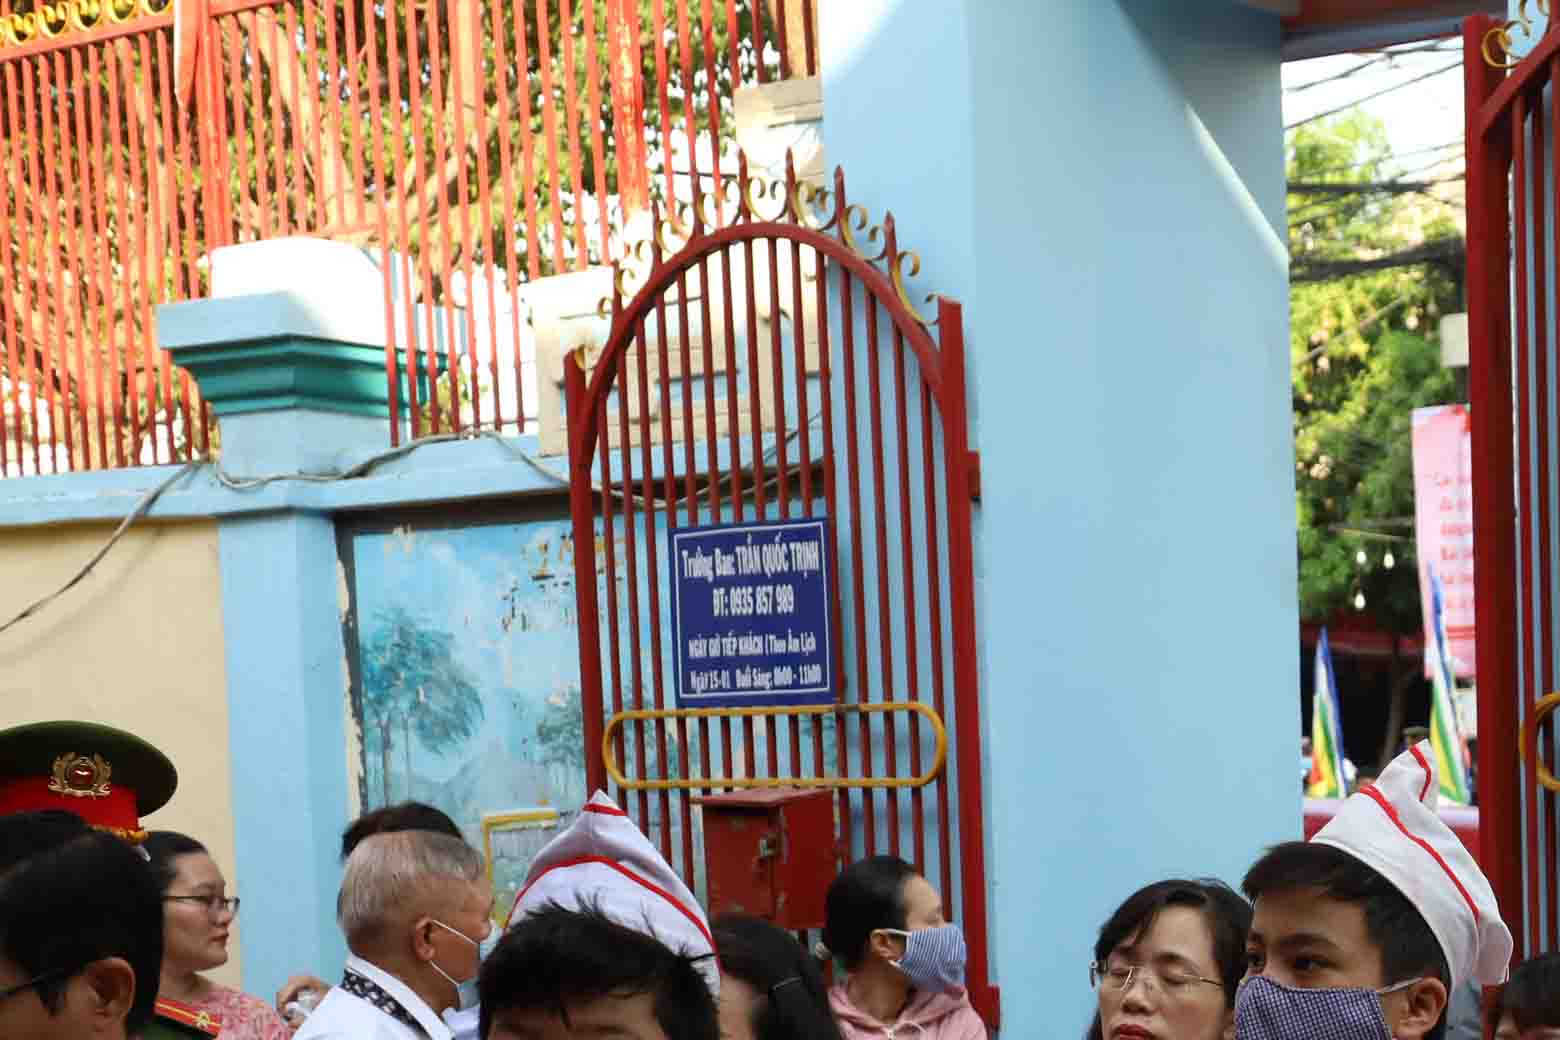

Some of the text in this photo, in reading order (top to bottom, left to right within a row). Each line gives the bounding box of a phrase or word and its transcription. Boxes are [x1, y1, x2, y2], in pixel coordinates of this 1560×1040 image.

[762, 532, 789, 578] QUỐC
[730, 585, 753, 616] 0935
[755, 585, 773, 615] 857
